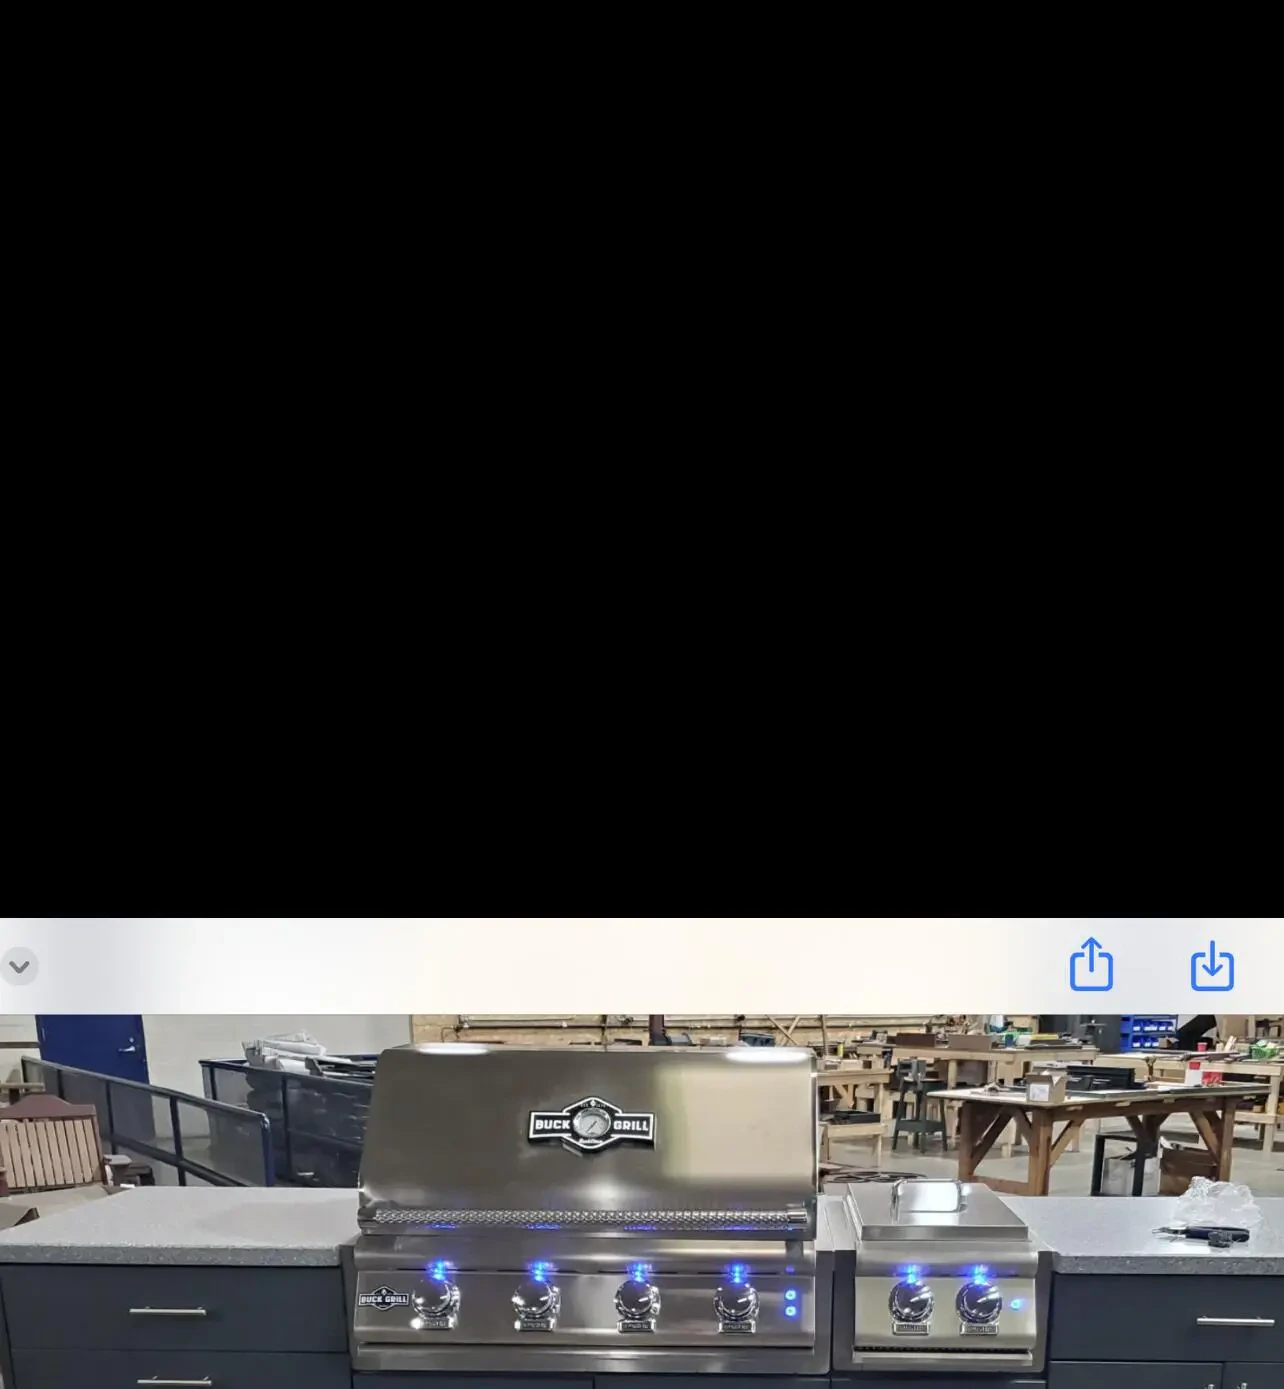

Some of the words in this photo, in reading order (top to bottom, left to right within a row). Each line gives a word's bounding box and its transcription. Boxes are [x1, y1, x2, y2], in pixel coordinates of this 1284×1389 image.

[535, 1119, 571, 1130] BUCK
[613, 1120, 650, 1131] GRILL
[361, 1295, 383, 1304] BUCK
[385, 1295, 407, 1303] GRILL
